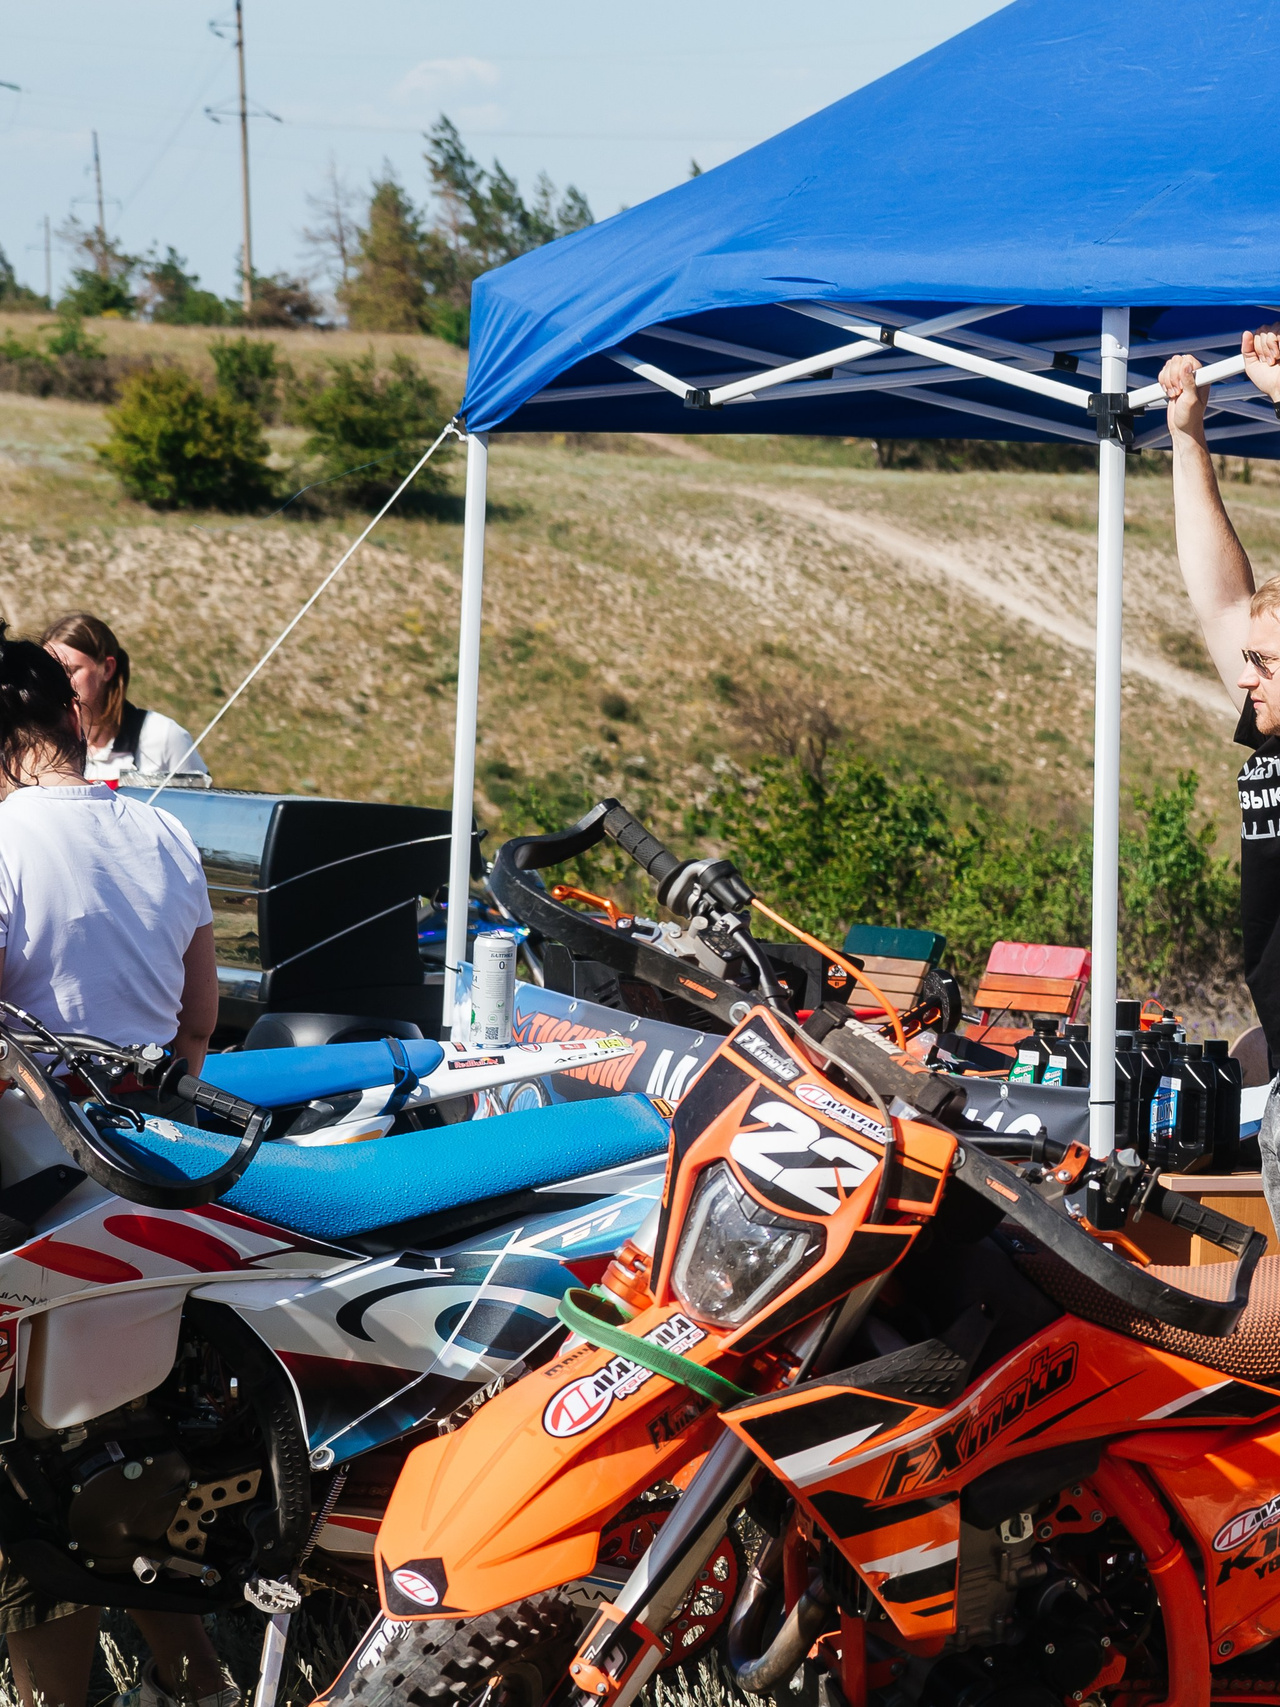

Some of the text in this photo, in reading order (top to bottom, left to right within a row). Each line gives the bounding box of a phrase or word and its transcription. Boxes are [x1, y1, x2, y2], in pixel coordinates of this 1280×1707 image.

[730, 1101, 879, 1215] 22
[595, 1317, 692, 1399] MAMA
[879, 1343, 1078, 1501] FXmoto
